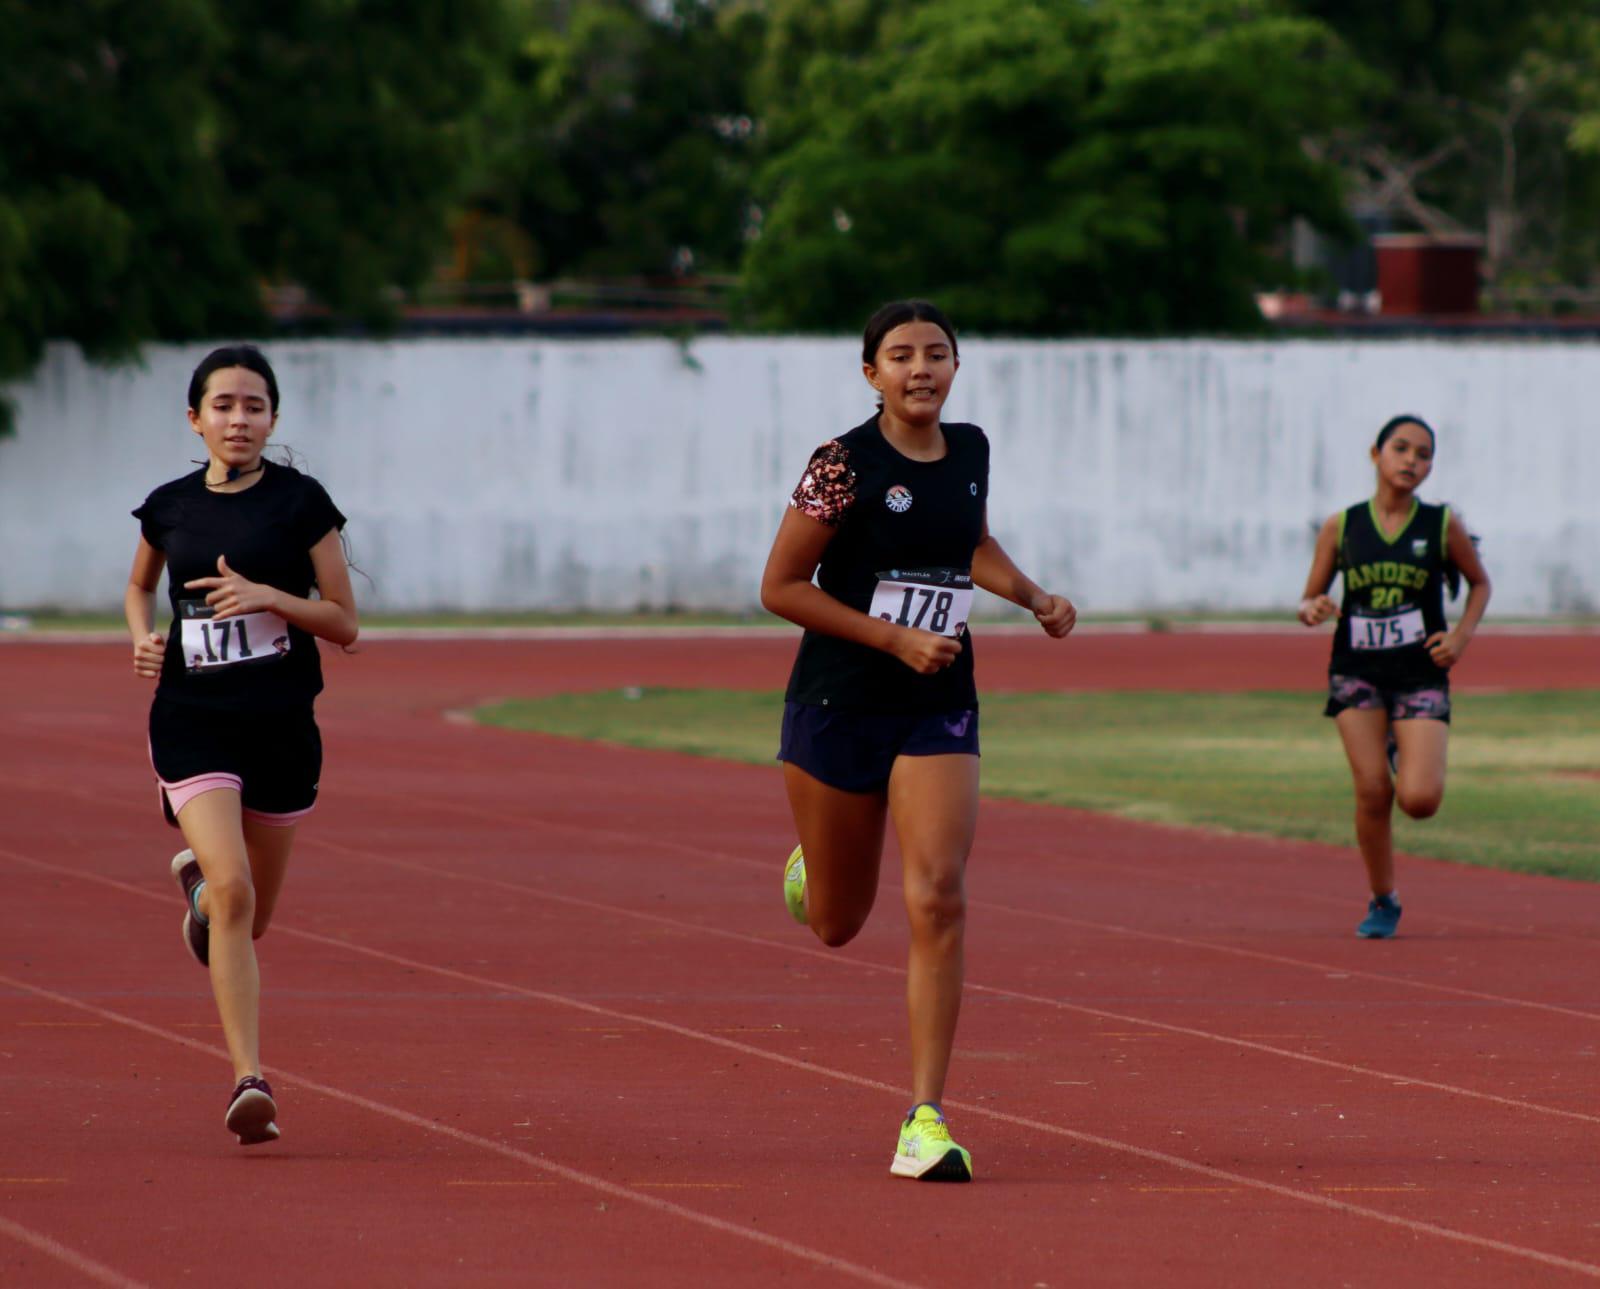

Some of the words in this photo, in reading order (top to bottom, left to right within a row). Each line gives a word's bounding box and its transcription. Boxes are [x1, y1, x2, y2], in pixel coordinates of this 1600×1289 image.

[1347, 561, 1429, 591] ANDES
[896, 587, 954, 633] 178
[1371, 586, 1404, 609] 20
[201, 619, 252, 662] 171
[1366, 620, 1404, 646] 175
